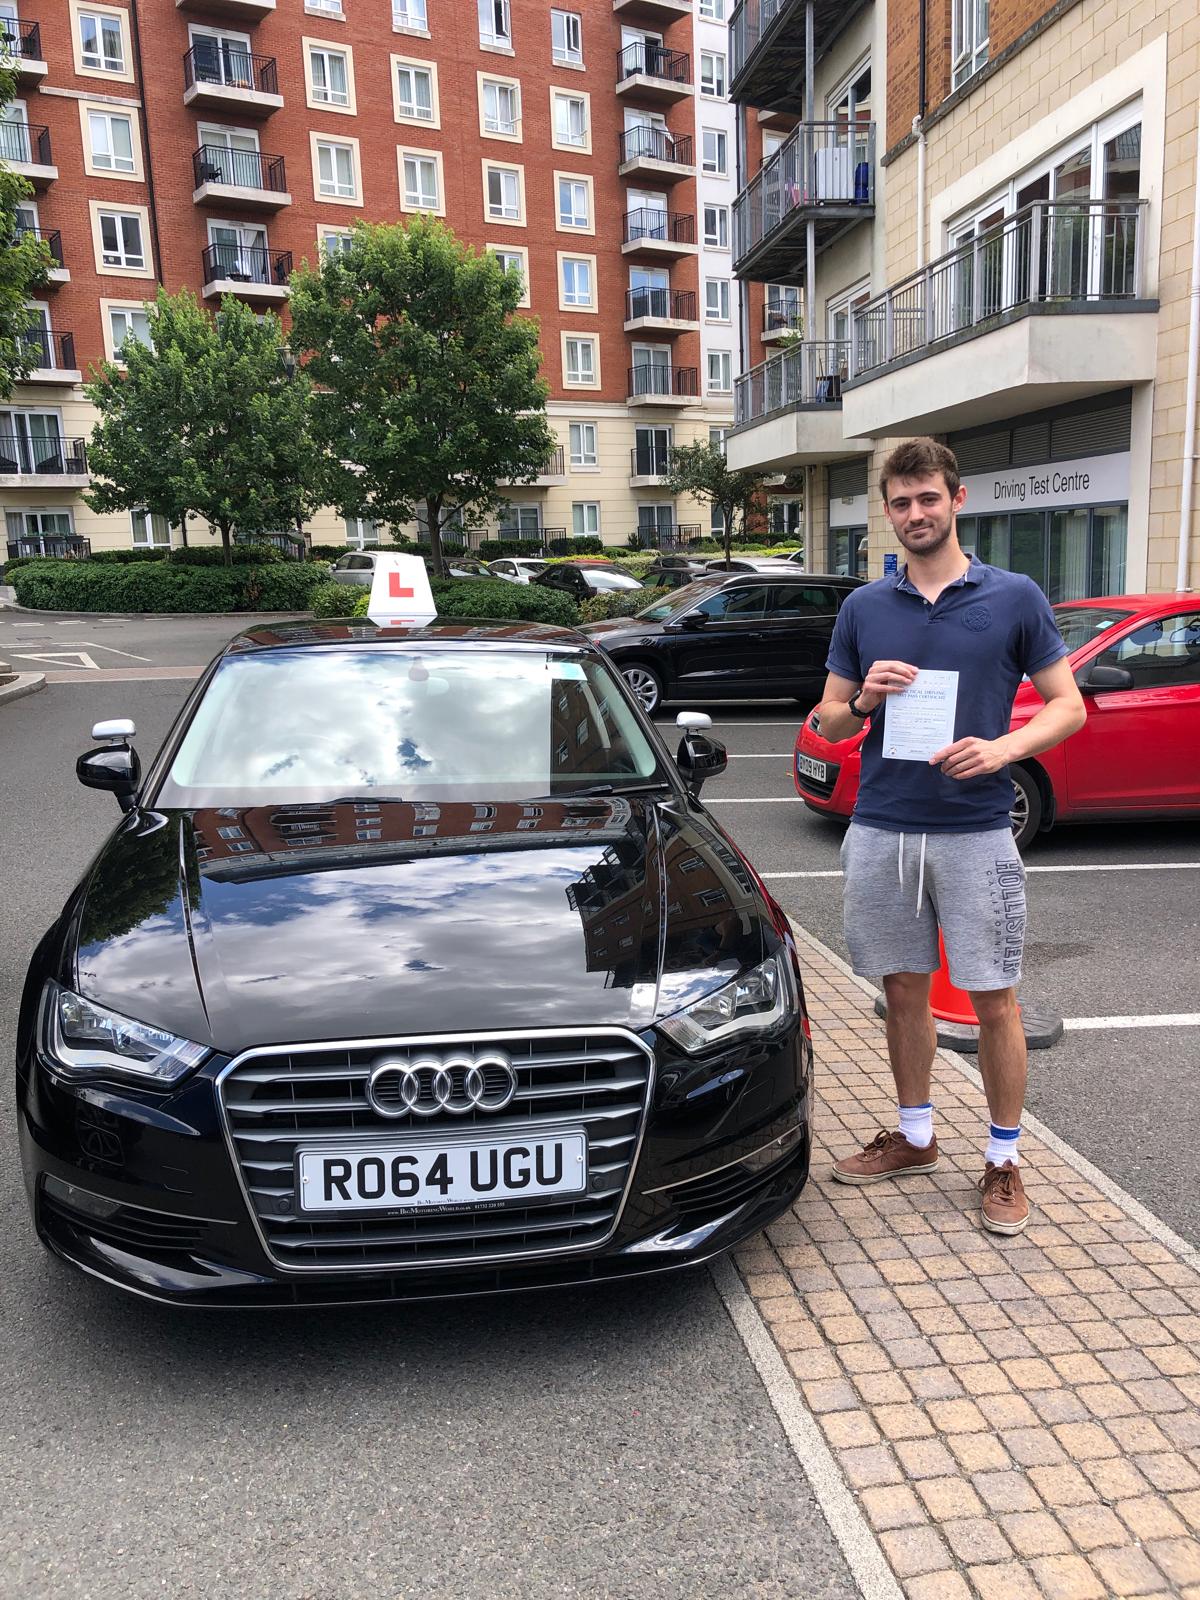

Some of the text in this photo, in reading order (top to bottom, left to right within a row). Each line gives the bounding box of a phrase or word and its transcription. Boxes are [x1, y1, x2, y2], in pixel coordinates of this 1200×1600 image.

[994, 471, 1090, 502] Driving Test Centre
[388, 572, 414, 598] L
[986, 870, 1001, 965] CALIFORNIA
[995, 859, 1026, 973] HOLLISTER
[323, 1143, 563, 1202] RO64 UGU
